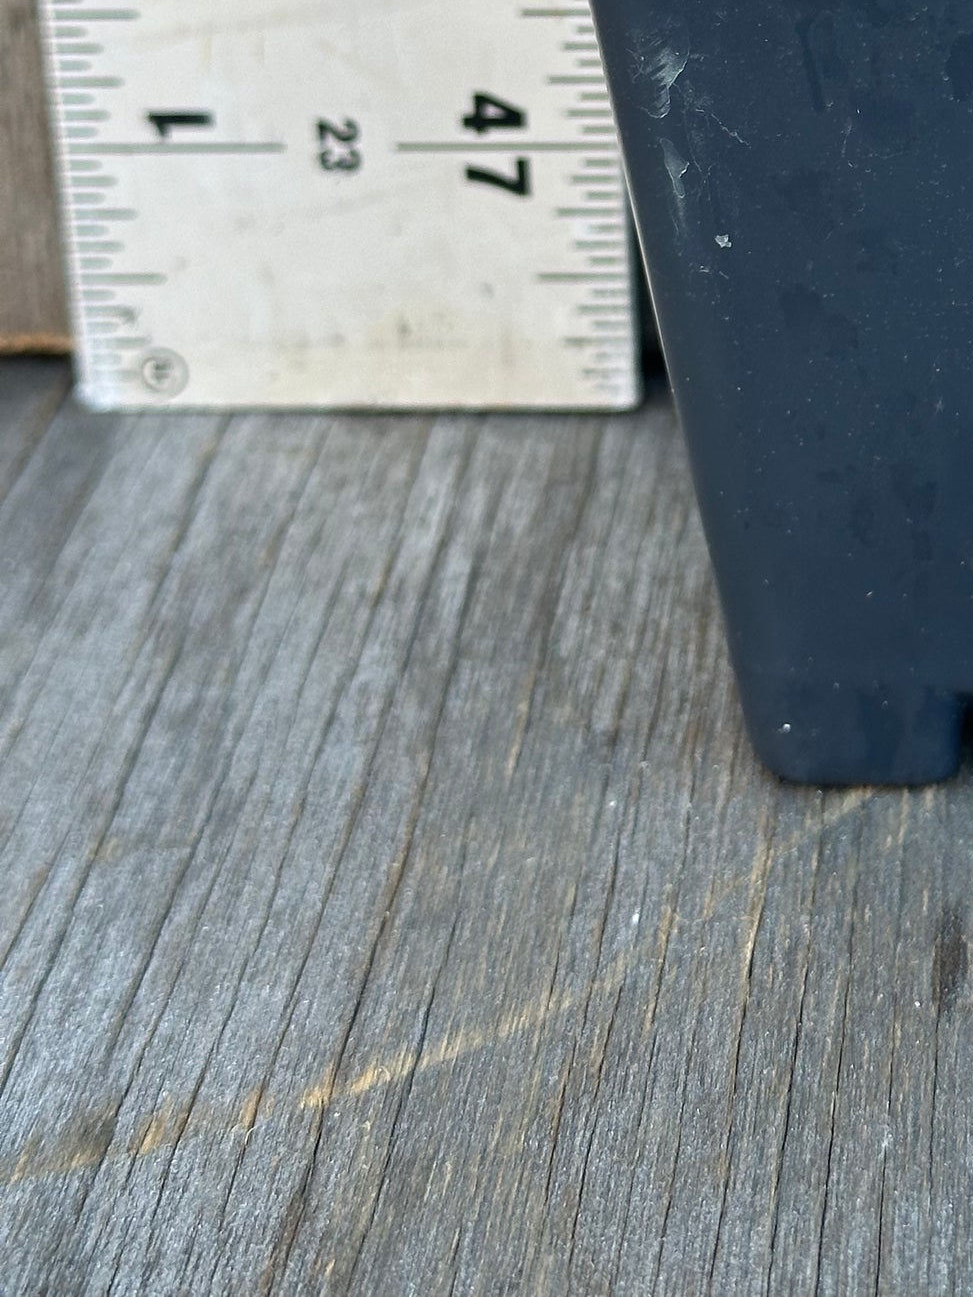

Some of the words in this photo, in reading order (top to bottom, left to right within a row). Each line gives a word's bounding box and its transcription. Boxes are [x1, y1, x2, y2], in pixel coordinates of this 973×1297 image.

[147, 112, 212, 138] 1
[317, 120, 360, 172] 23
[461, 92, 532, 198] 47
